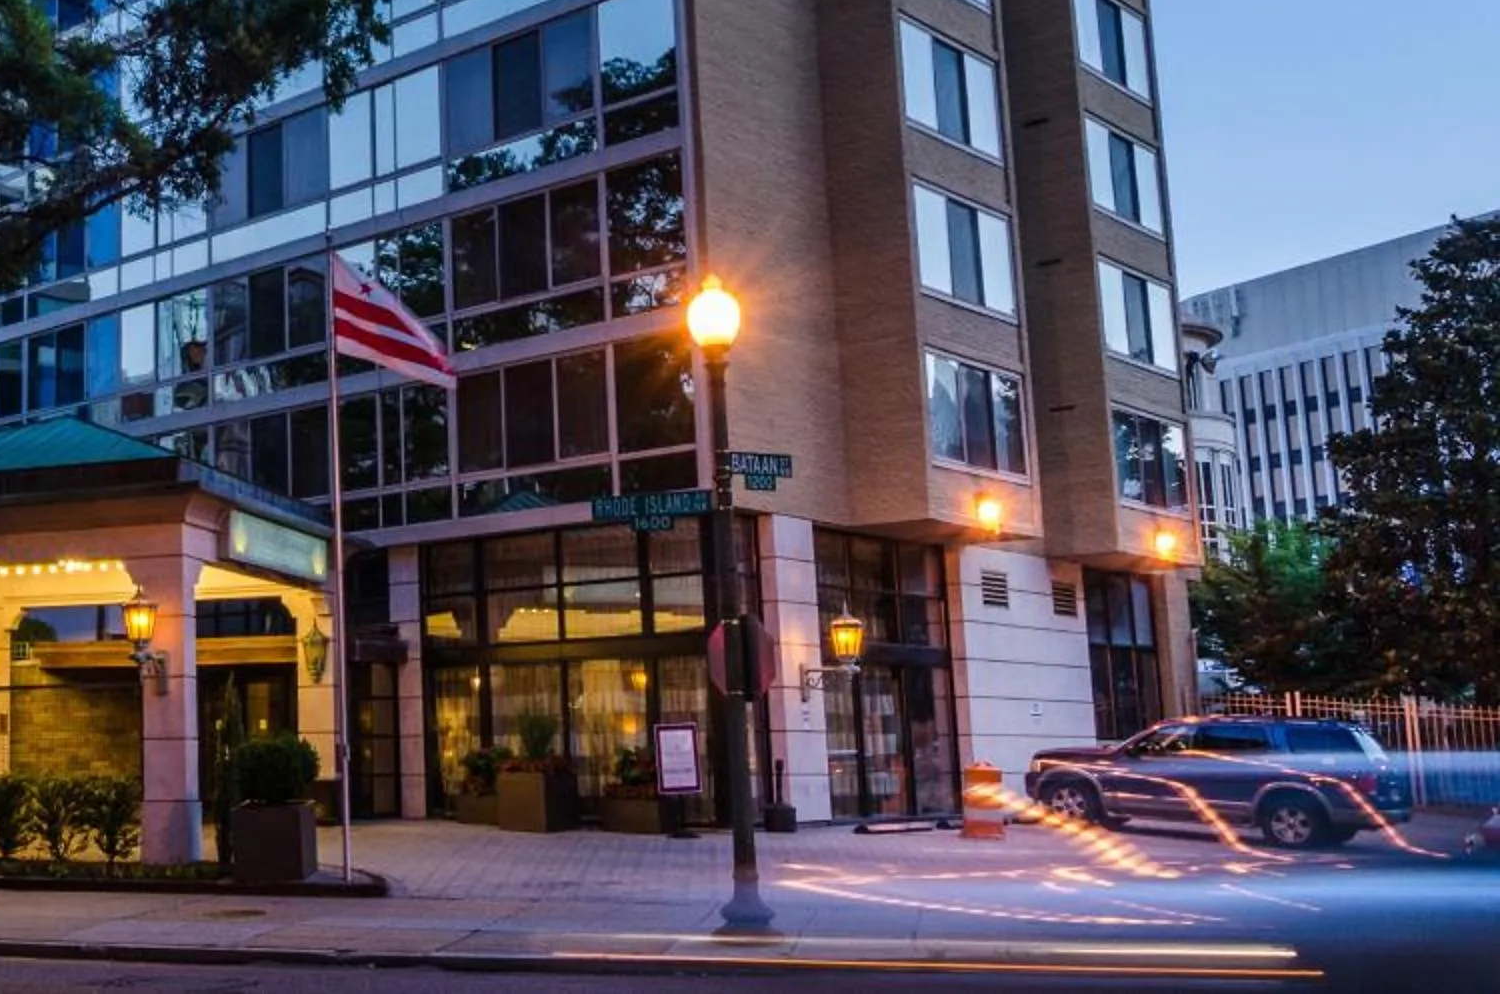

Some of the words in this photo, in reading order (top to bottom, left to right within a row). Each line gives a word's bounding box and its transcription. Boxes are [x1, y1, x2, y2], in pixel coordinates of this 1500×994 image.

[731, 454, 778, 475] BATAAN
[595, 496, 637, 517] RHODE
[645, 492, 691, 513] ISLAND
[634, 516, 671, 530] 1600
